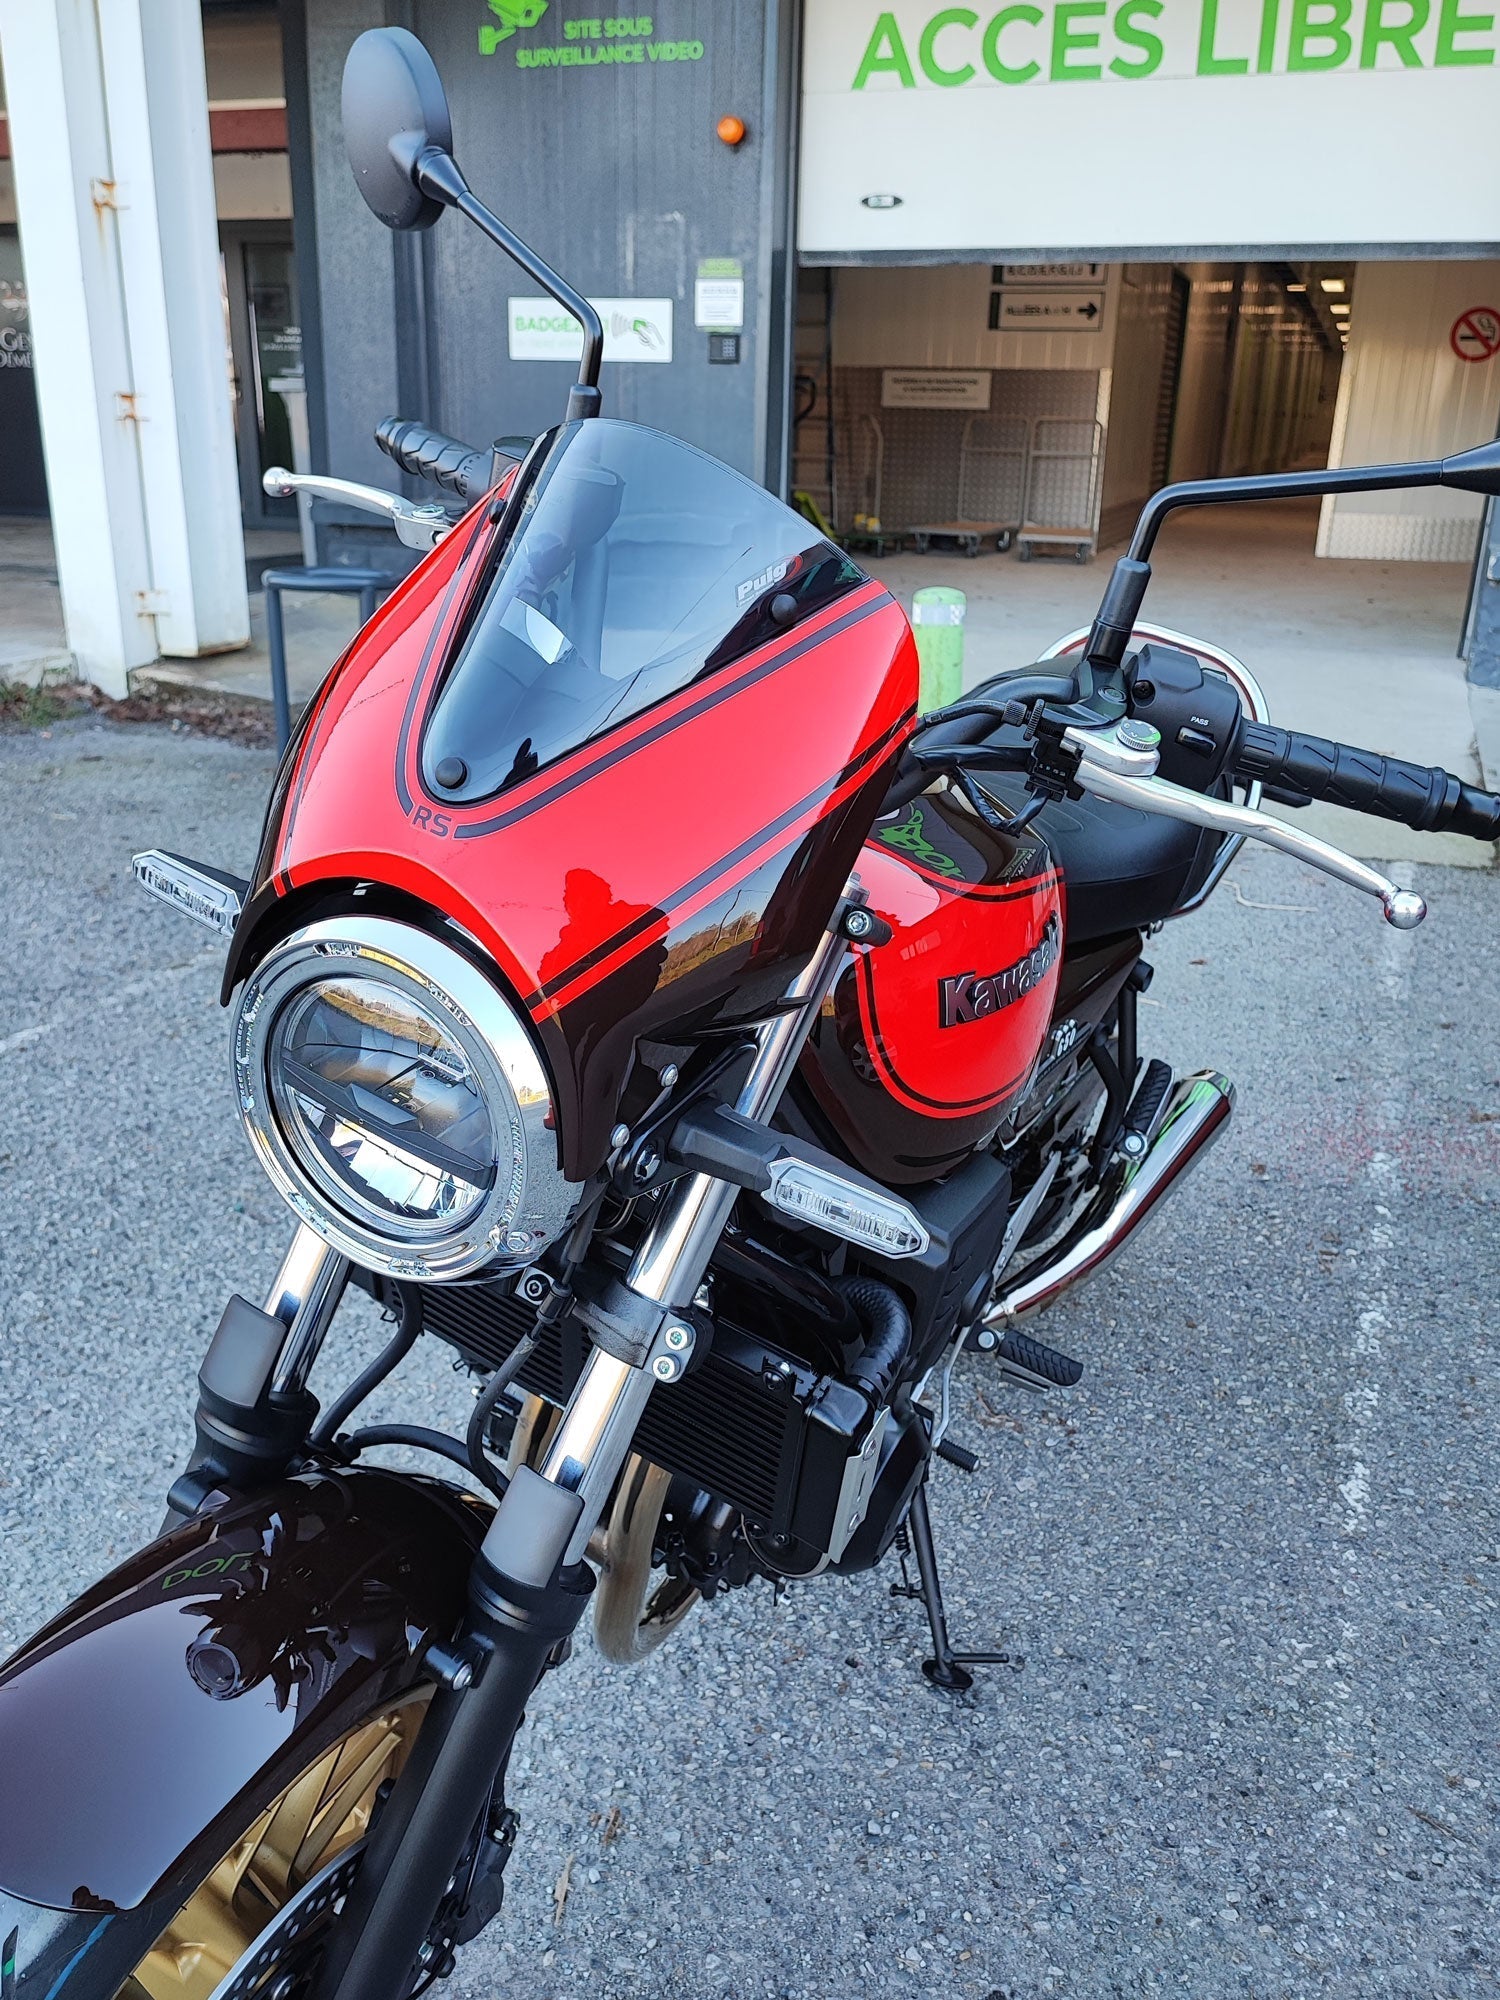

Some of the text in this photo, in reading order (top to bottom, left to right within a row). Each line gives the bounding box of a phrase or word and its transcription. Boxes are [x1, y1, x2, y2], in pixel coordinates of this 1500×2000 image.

[563, 16, 654, 40] SITE SOUS
[515, 40, 705, 69] SURVEILLANCE VIDEO
[852, 0, 1496, 89] ACCES LIBRE
[737, 560, 788, 602] Puig
[1190, 715, 1210, 727] PASS
[412, 805, 452, 837] RS
[939, 910, 1059, 1029] Kawasak
